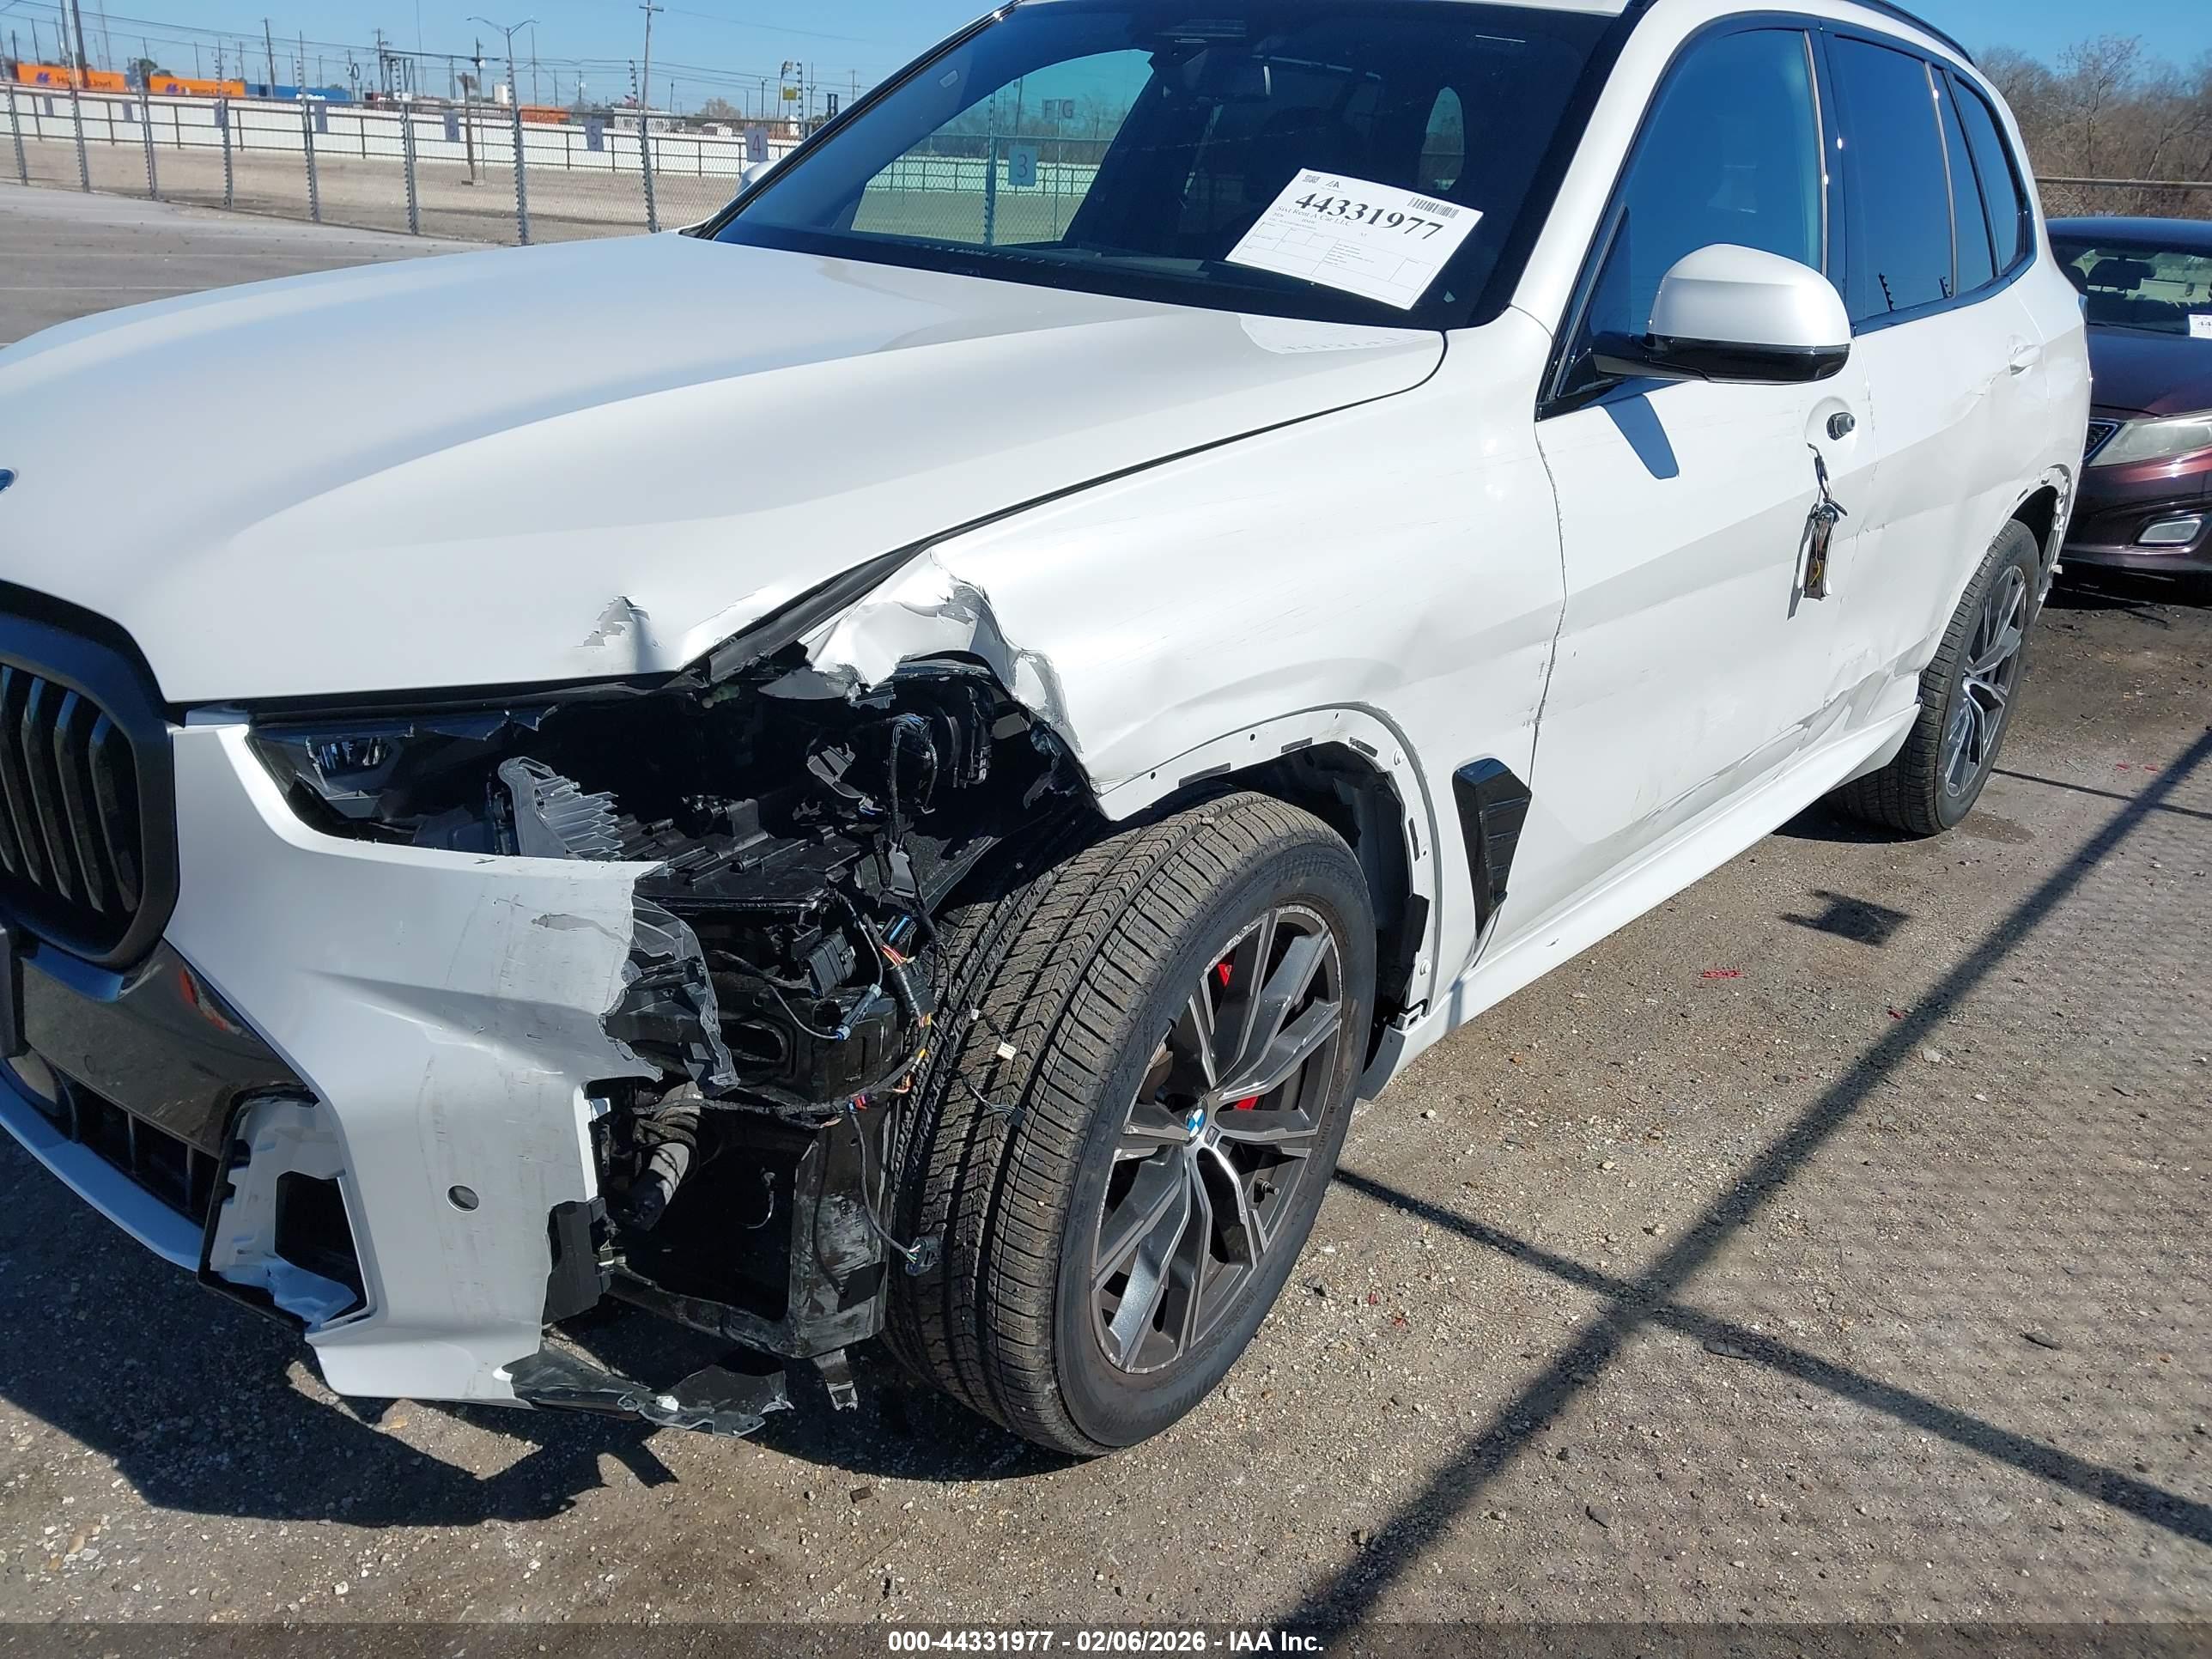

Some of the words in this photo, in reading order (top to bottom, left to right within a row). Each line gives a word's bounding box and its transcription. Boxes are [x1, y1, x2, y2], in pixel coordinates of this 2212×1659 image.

[1062, 100, 1074, 118] G
[590, 125, 599, 145] 5
[752, 134, 762, 156] 4
[1017, 154, 1028, 178] 3
[1295, 192, 1444, 240] 44331977
